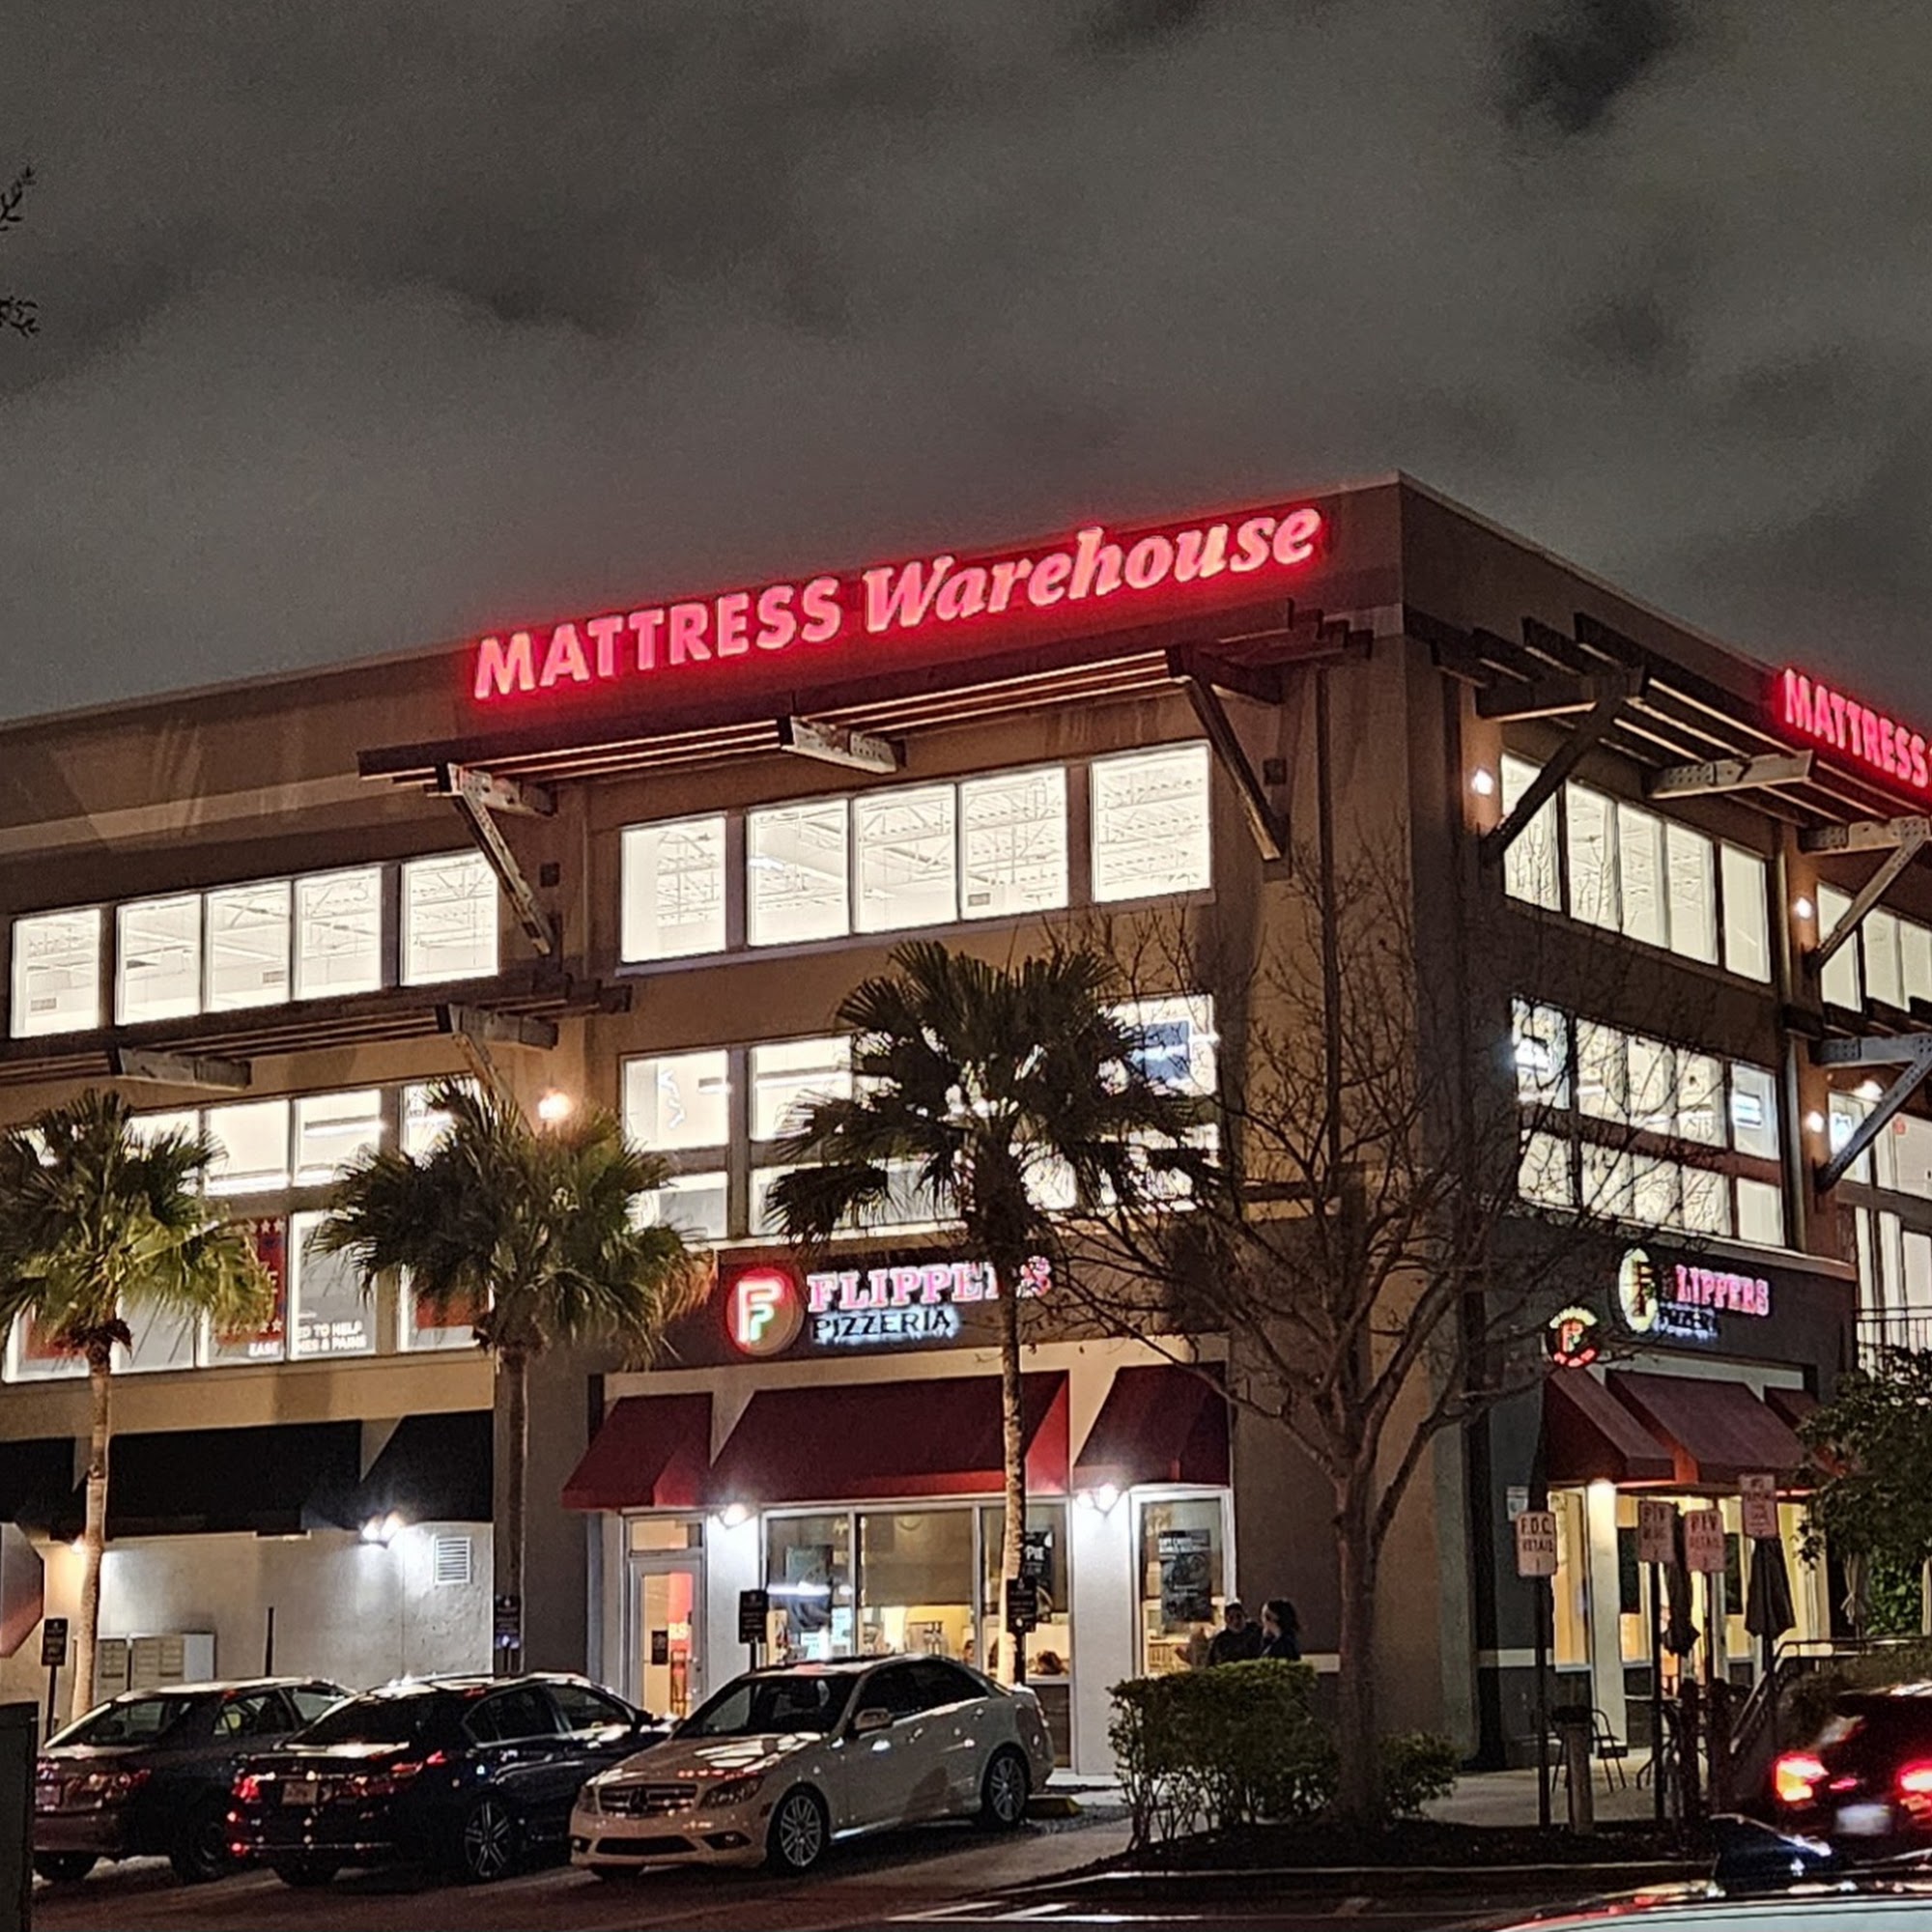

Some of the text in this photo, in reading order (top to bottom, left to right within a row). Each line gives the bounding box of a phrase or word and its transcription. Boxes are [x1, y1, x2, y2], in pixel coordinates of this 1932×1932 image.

[473, 507, 1322, 699] MATTRESS Warehouse
[1784, 668, 1929, 789] MATTRESS
[807, 1255, 1053, 1314] FLIPPES
[812, 1308, 952, 1340] PIZZERIA
